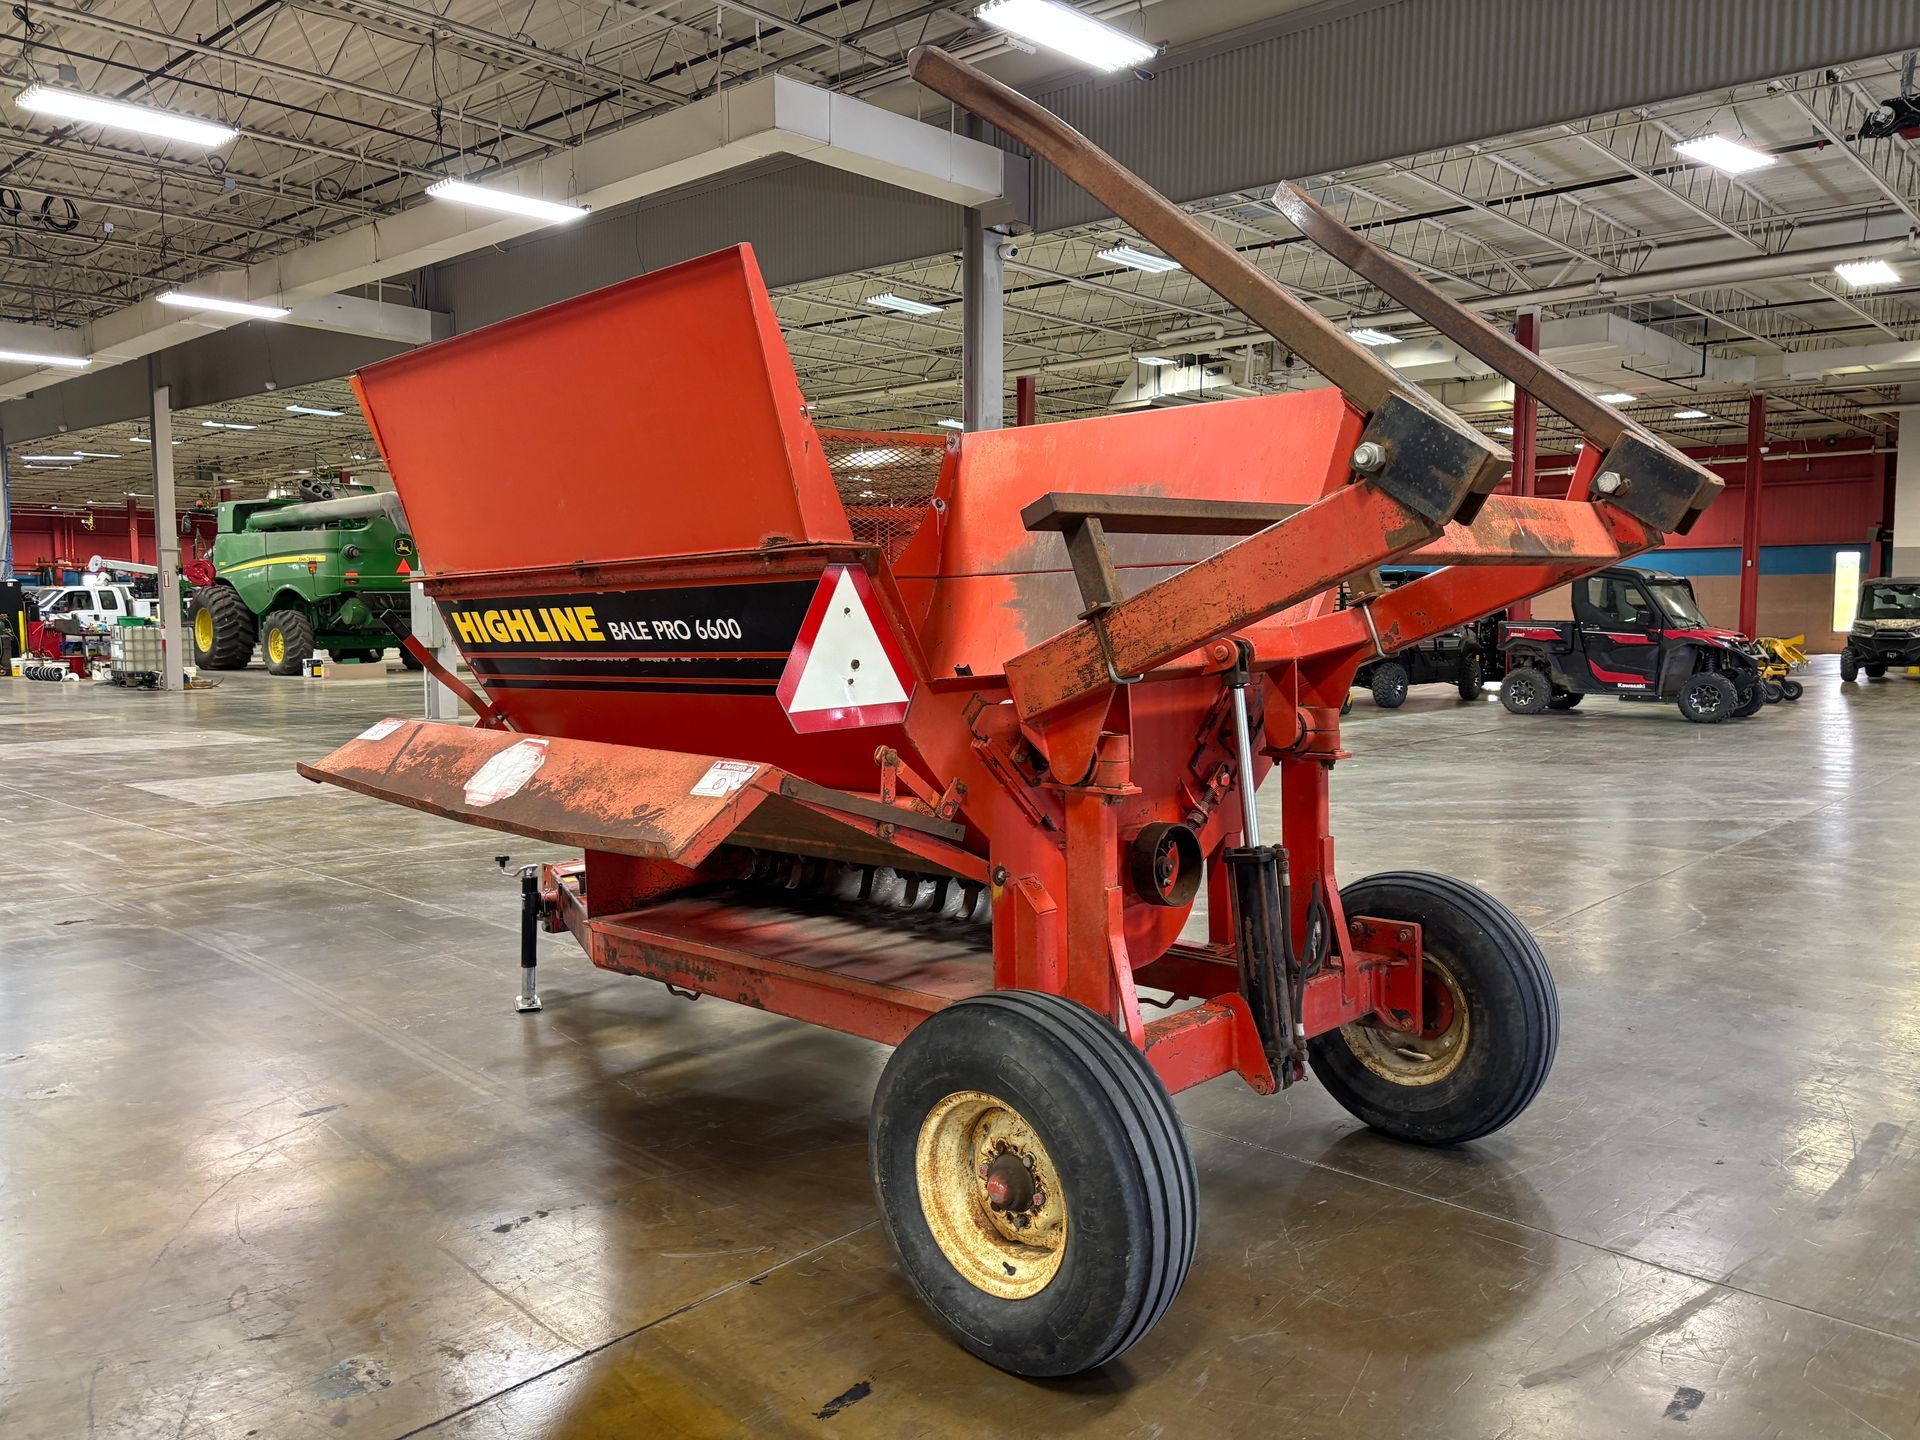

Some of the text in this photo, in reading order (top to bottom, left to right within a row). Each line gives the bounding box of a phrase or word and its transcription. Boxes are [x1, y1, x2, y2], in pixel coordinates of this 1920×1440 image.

[451, 607, 742, 643] HIGHLINE BALE PRO 6600
[722, 763, 747, 772] DANGER
